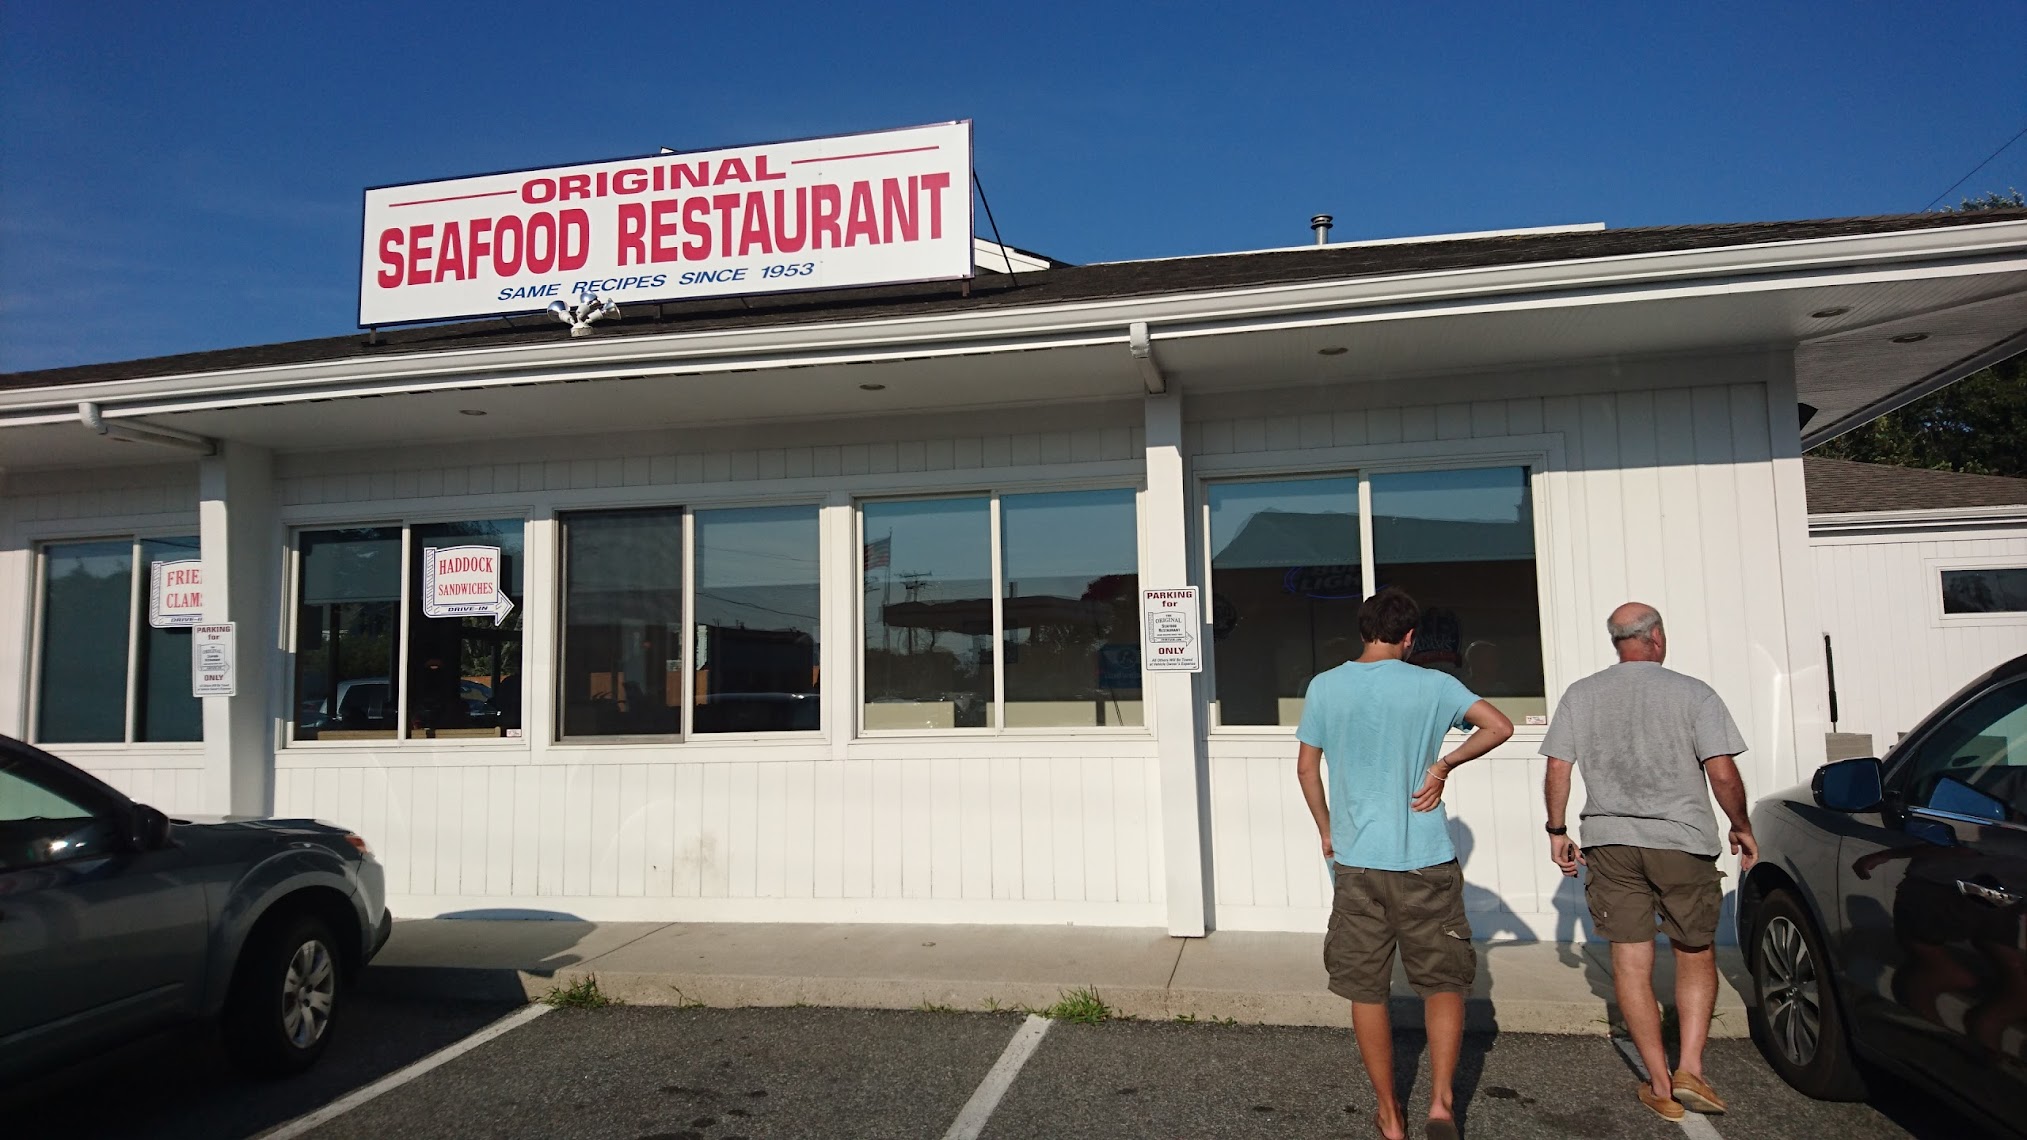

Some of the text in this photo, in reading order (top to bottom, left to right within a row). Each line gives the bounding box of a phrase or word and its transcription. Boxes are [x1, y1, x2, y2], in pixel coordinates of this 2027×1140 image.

[521, 154, 786, 204] ORIGINAL
[377, 172, 950, 289] SEAFOOD RESTAURANT
[498, 262, 815, 301] SAME RECIPES SINCE 1953
[439, 556, 493, 575] HADDOCK
[166, 569, 202, 588] FRIE
[438, 582, 493, 596] SANDWICHES
[1147, 591, 1192, 599] PARKING
[166, 592, 202, 609] CLAM
[1162, 600, 1178, 608] for
[196, 626, 231, 634] PARKING
[1158, 647, 1185, 655] ONLY
